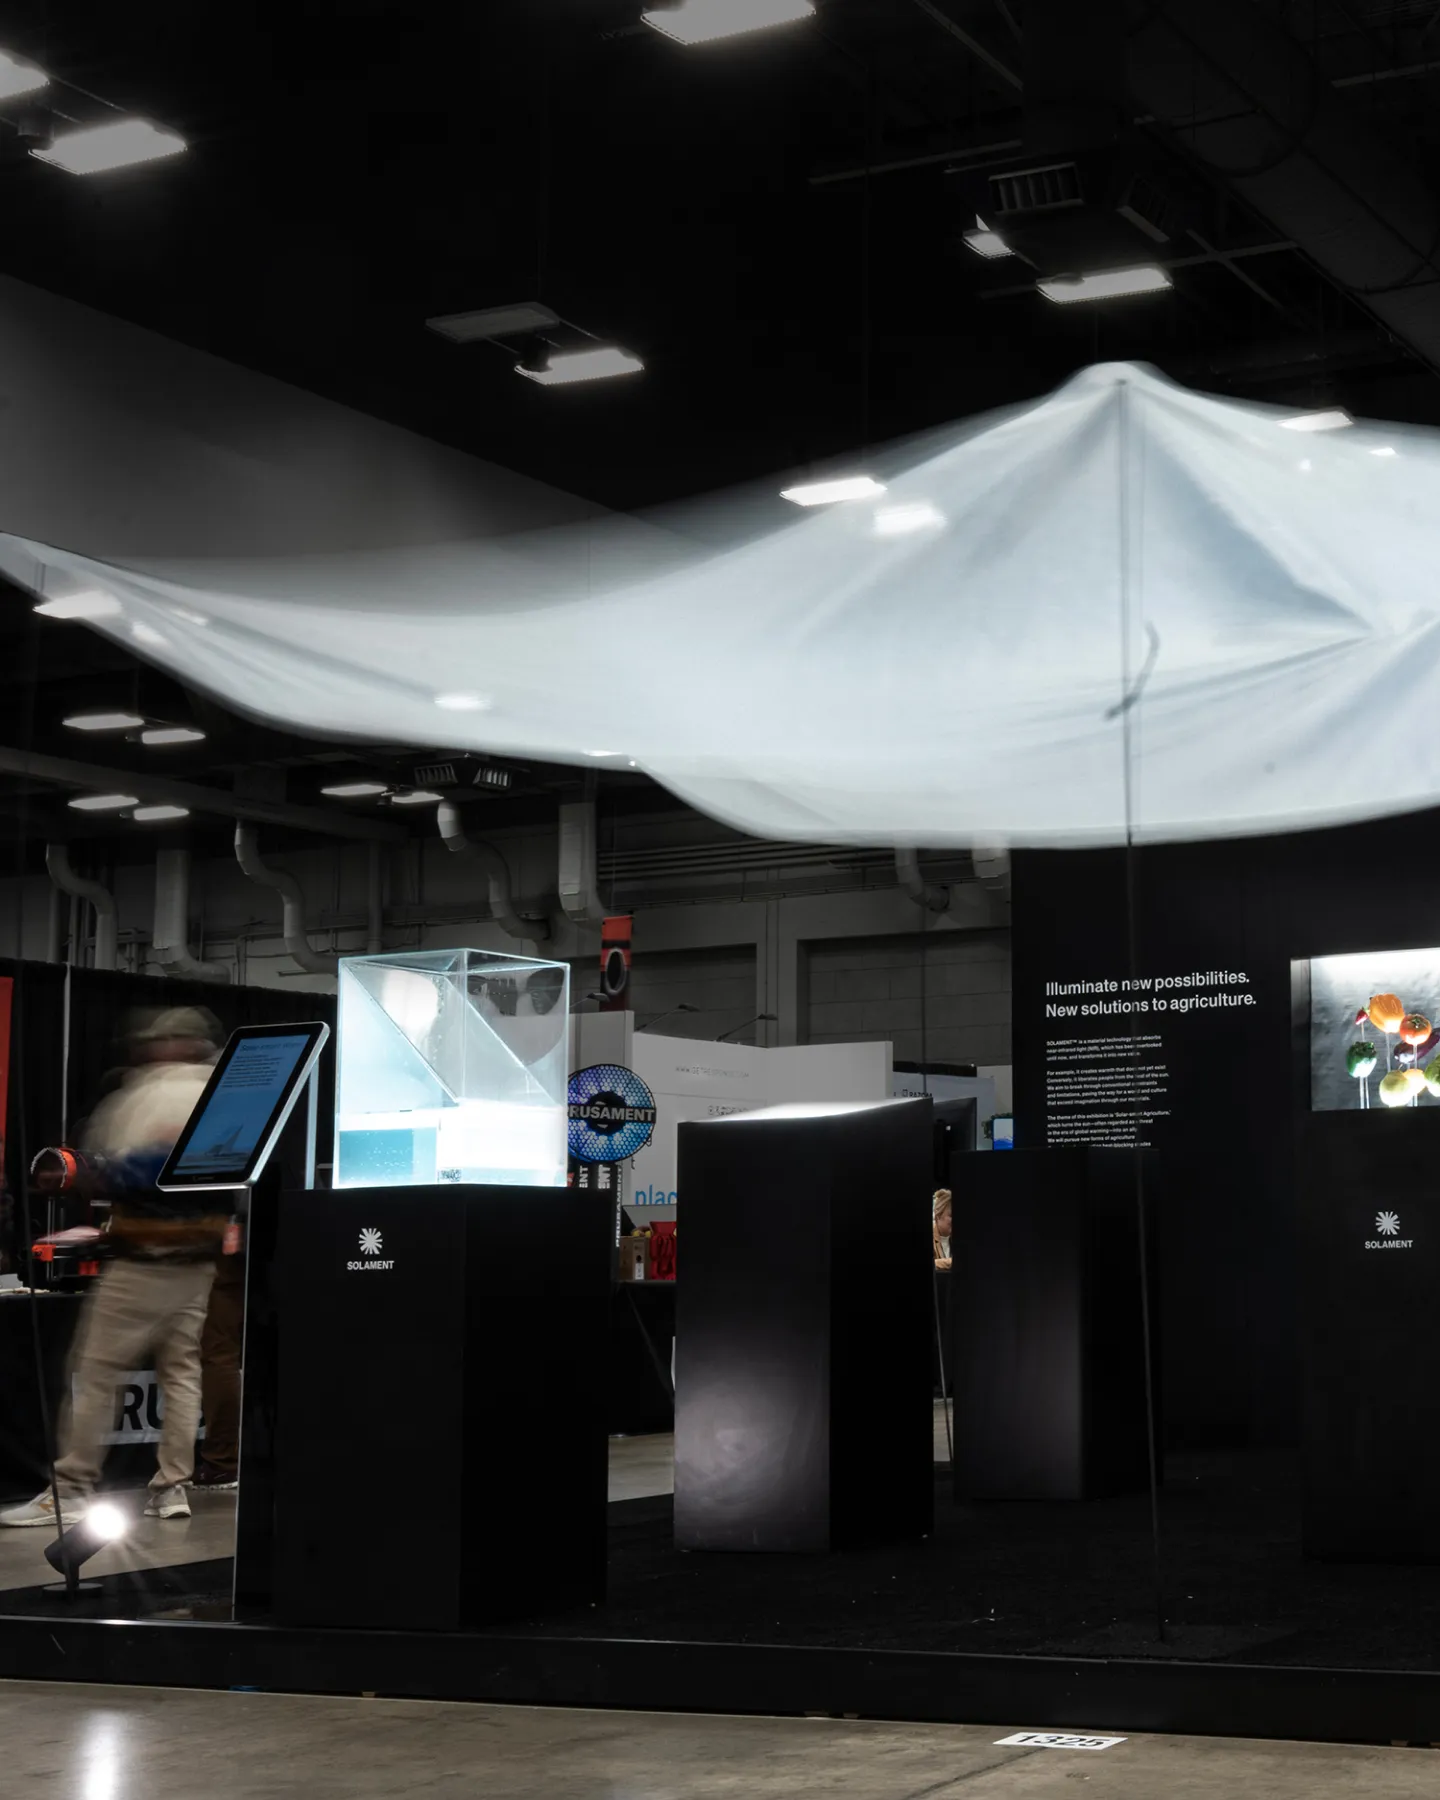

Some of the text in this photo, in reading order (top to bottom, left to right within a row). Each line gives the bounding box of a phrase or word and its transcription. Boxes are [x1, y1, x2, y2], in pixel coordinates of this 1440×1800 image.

[1046, 970, 1250, 996] Illuminate new possibilities.
[1046, 992, 1256, 1018] New solutions to agriculture.
[567, 1105, 655, 1122] RUSAMENT
[1364, 1239, 1414, 1250] SOLAMENT
[346, 1260, 395, 1271] SOLAMENT
[1017, 1735, 1110, 1747] 1325
